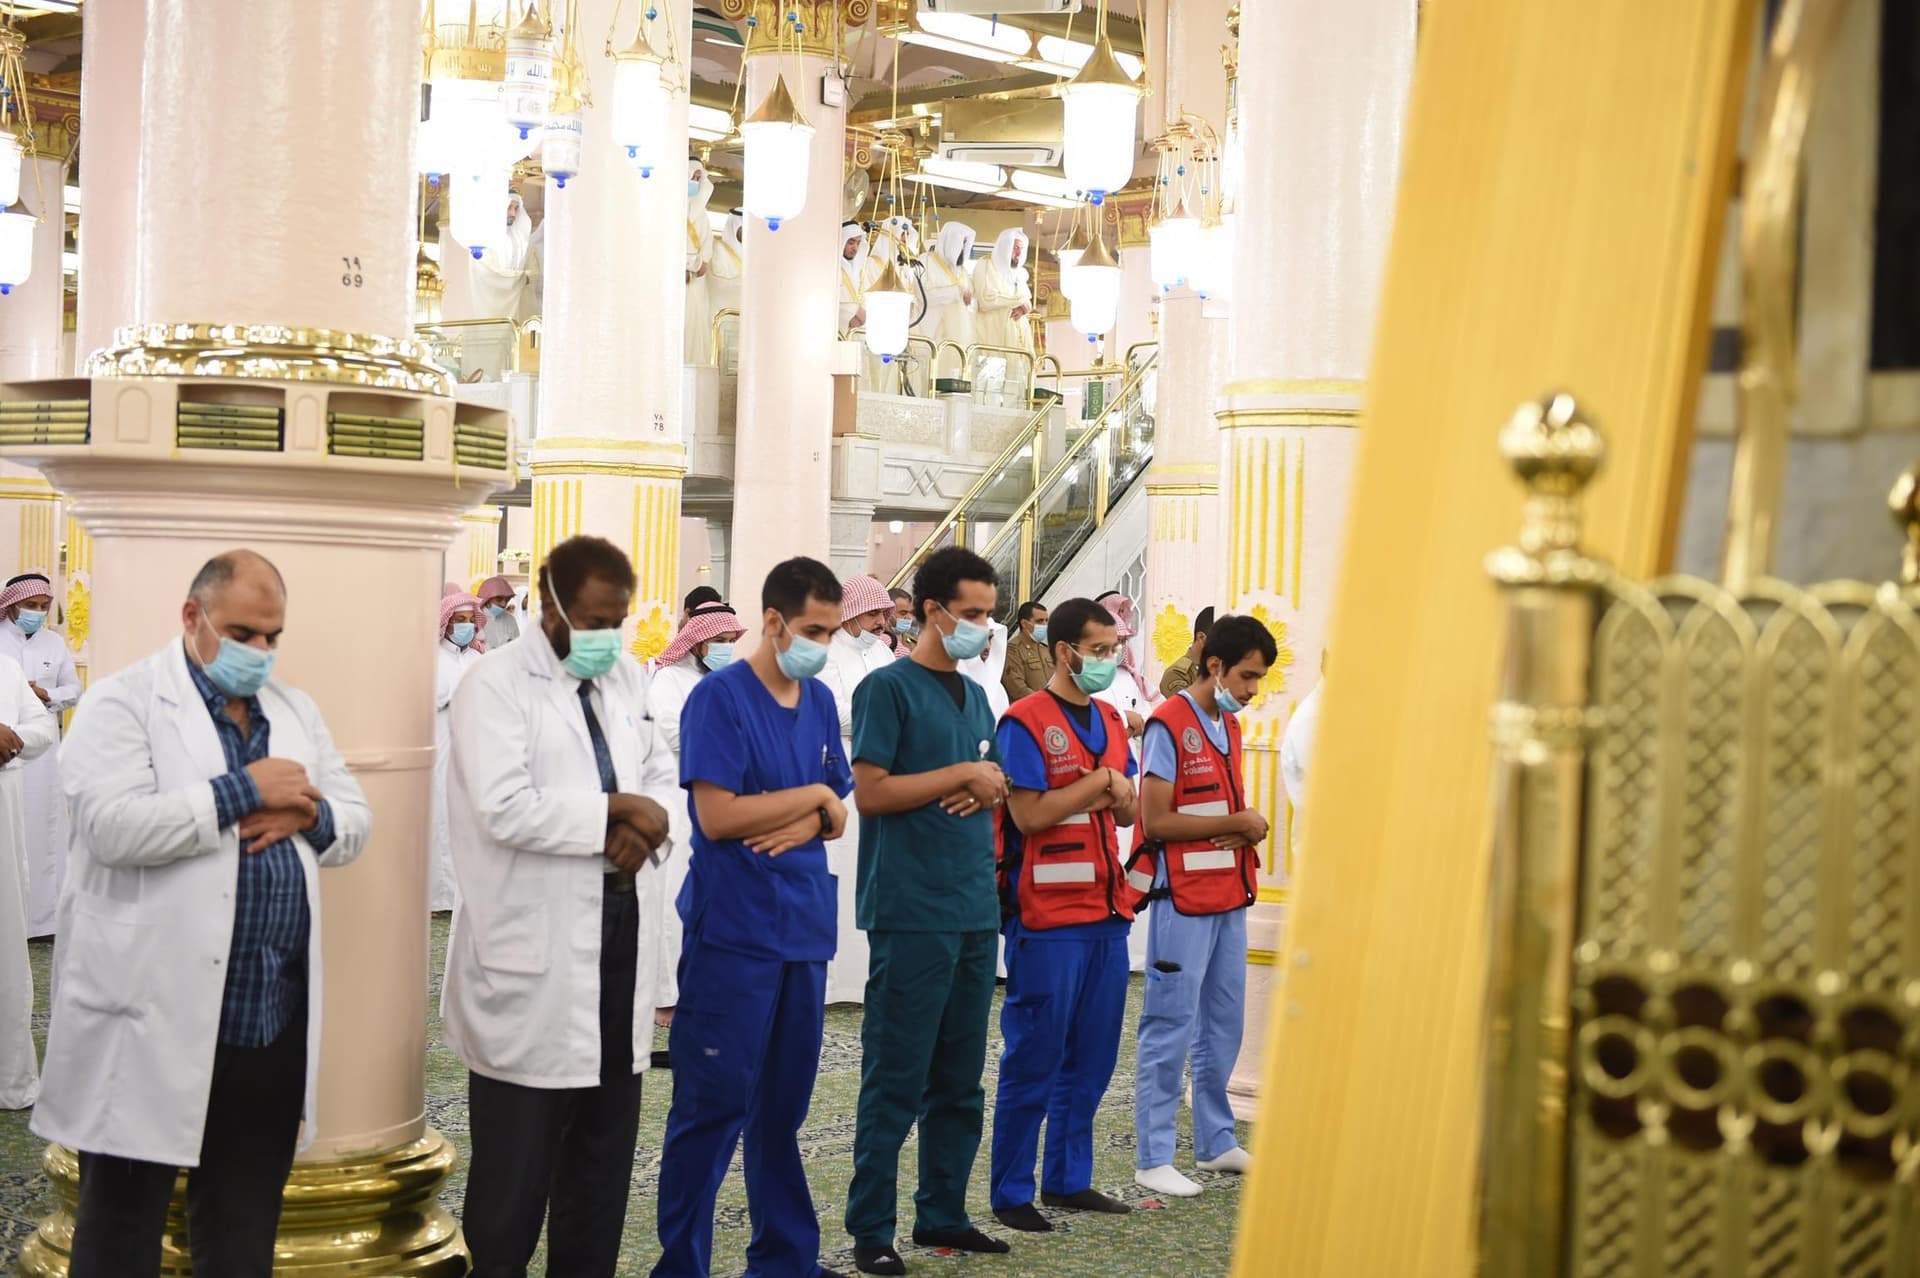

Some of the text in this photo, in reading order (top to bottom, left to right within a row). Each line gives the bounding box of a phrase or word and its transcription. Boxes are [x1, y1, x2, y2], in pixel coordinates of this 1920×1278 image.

[342, 256, 362, 271] ٦٩
[342, 273, 364, 289] 69
[653, 413, 664, 421] ٧٨
[653, 422, 665, 432] 78
